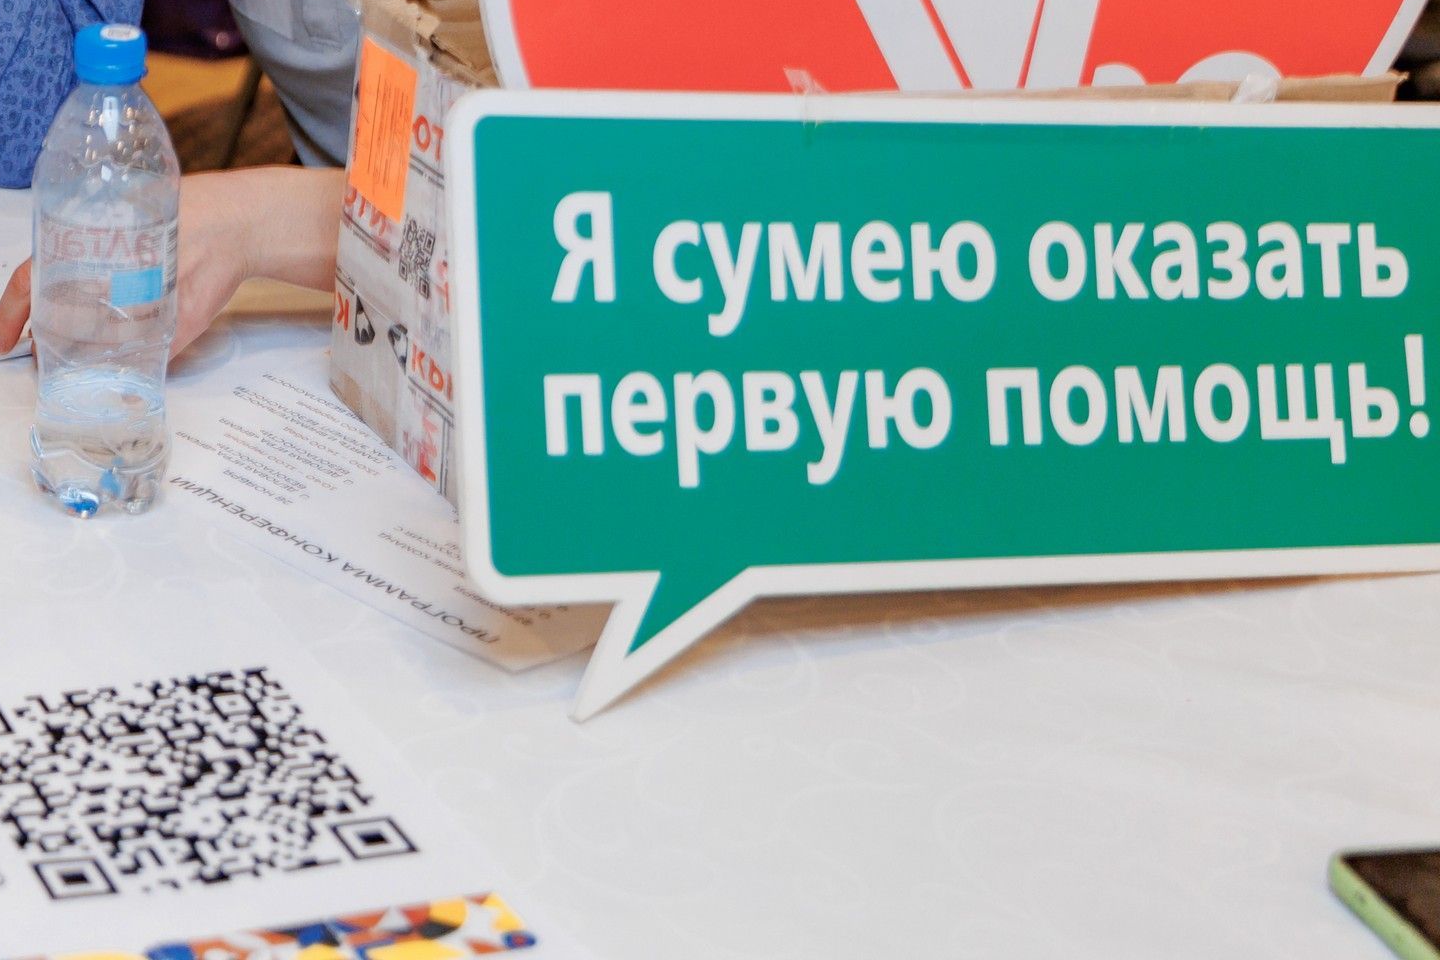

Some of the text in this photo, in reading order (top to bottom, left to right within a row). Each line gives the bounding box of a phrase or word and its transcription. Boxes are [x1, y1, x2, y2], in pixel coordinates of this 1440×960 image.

[551, 191, 615, 302] Я
[652, 221, 996, 337] сумею
[1028, 222, 1409, 302] оказать
[543, 368, 952, 488] первую
[985, 334, 1430, 465] помощь!
[222, 470, 274, 497] НОЯБРЯ
[243, 464, 298, 493] ДЕЛОВАЯ
[287, 450, 341, 480] ДЕЛОВАЯ
[168, 476, 501, 645] ПРОГРАММА КОНФЕРЕНЦИИ
